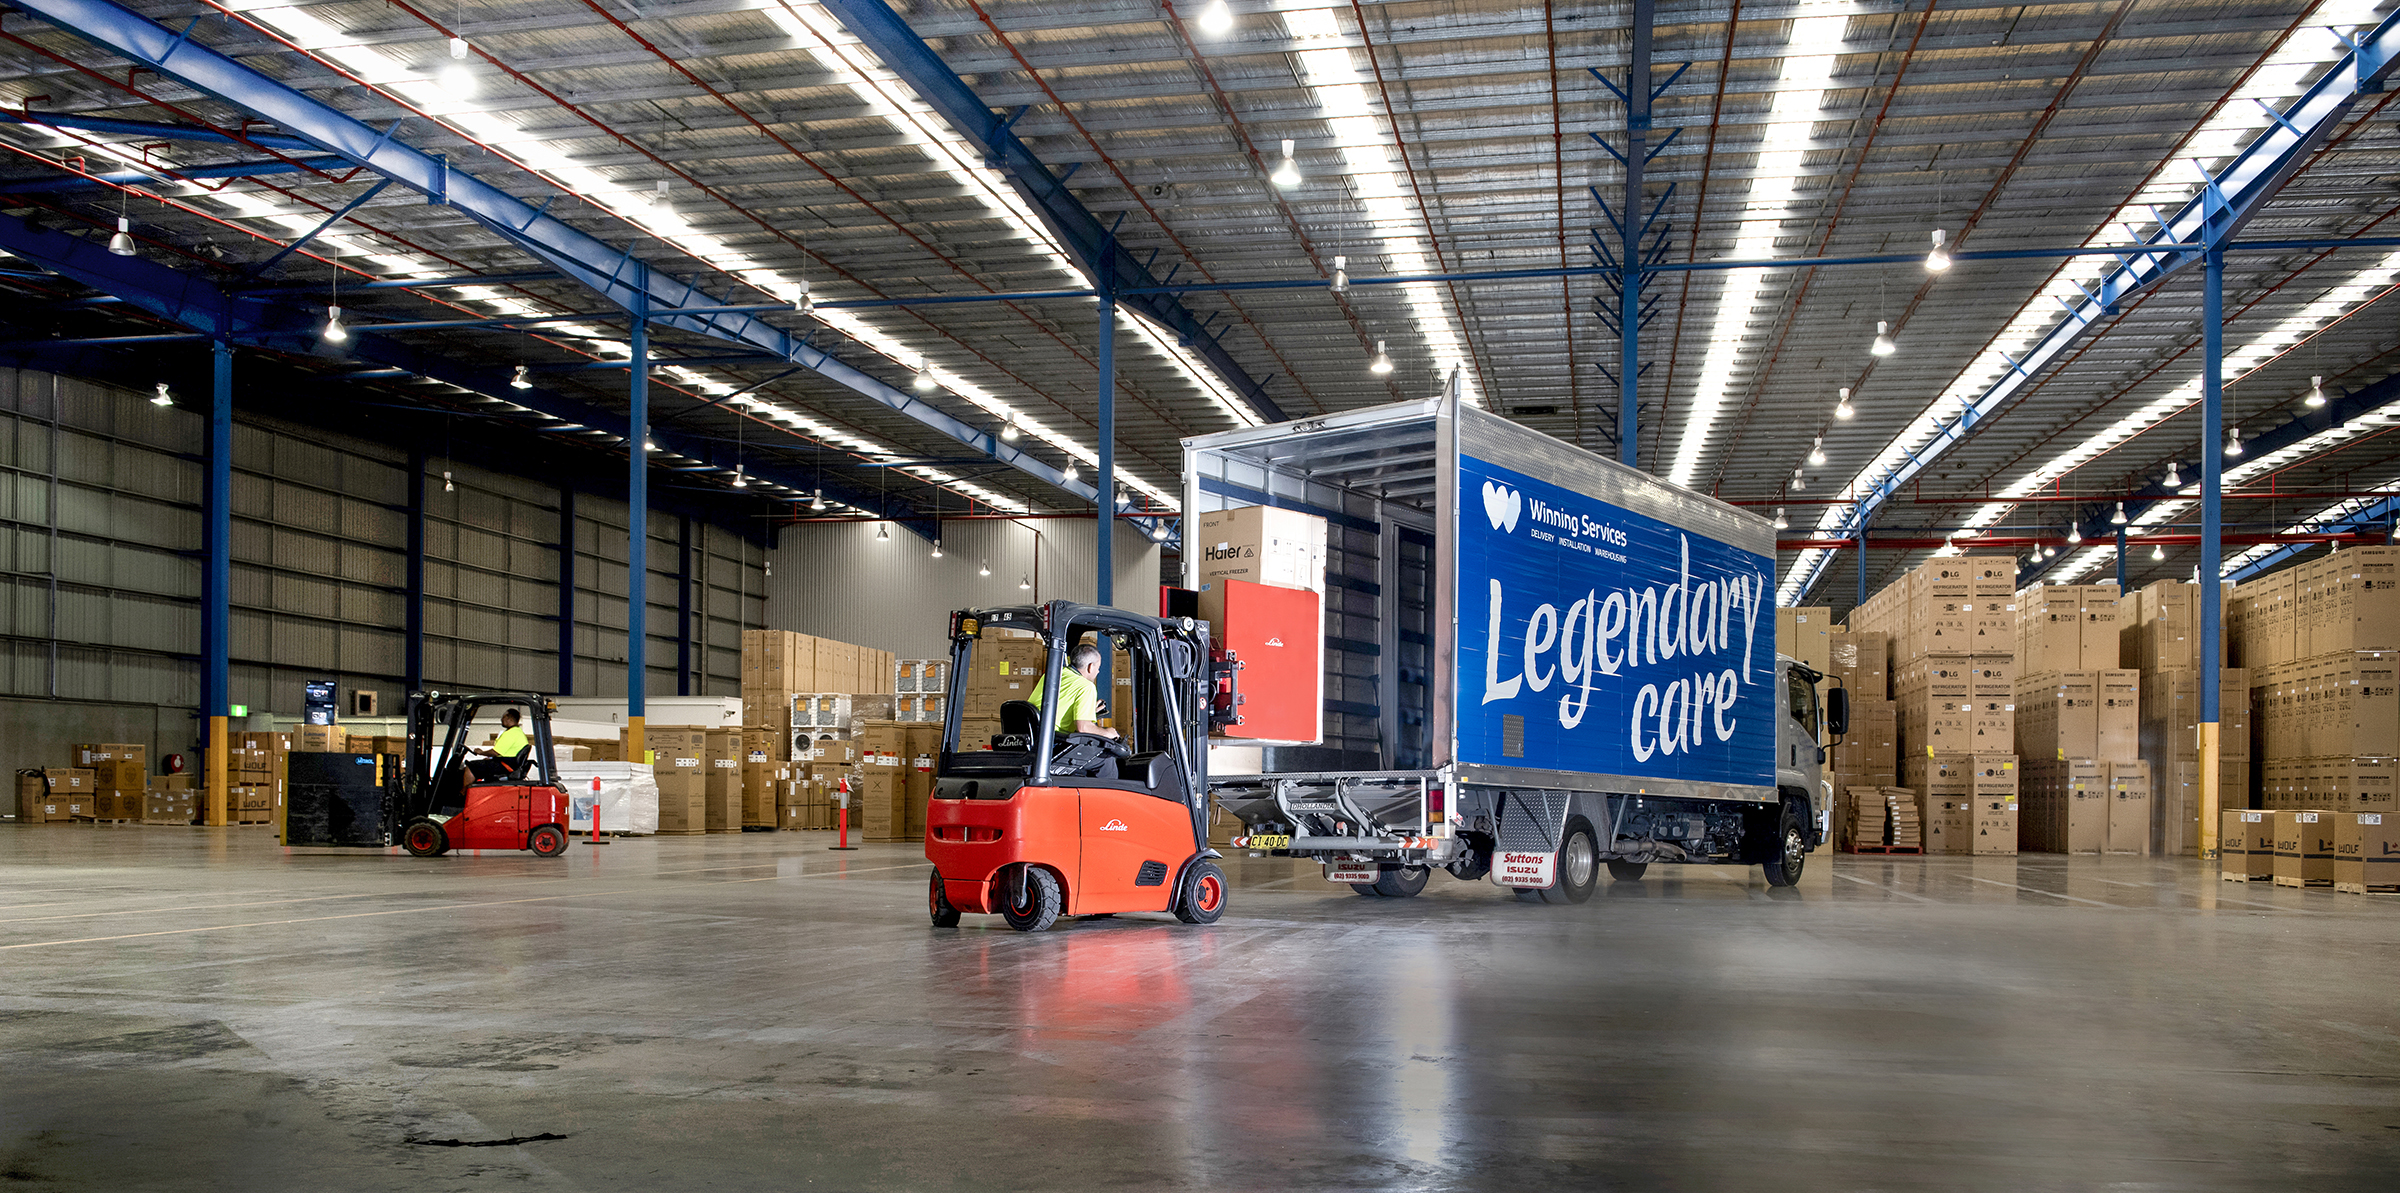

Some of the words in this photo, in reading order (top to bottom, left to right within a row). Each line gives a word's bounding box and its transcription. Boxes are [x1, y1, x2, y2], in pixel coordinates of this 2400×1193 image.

[1529, 497, 1578, 537] Winning
[1582, 514, 1627, 547] Services
[1531, 528, 1554, 542] DELIVERY
[1559, 537, 1591, 553] INSTALLATION
[1595, 547, 1627, 564] WAREHOUSING
[1205, 546, 1241, 561] Haier
[1482, 533, 1763, 729] Legendary
[1265, 637, 1283, 647] Linde
[1631, 669, 1737, 762] care
[998, 735, 1023, 747] Linde
[243, 800, 266, 808] WOLF
[1100, 819, 1128, 831] Linde
[2225, 839, 2242, 847] WOLF
[2278, 841, 2297, 850] WOLF
[2339, 844, 2359, 854] WOLF
[1504, 853, 1544, 864] Suttons
[1507, 866, 1538, 874] ISUZU
